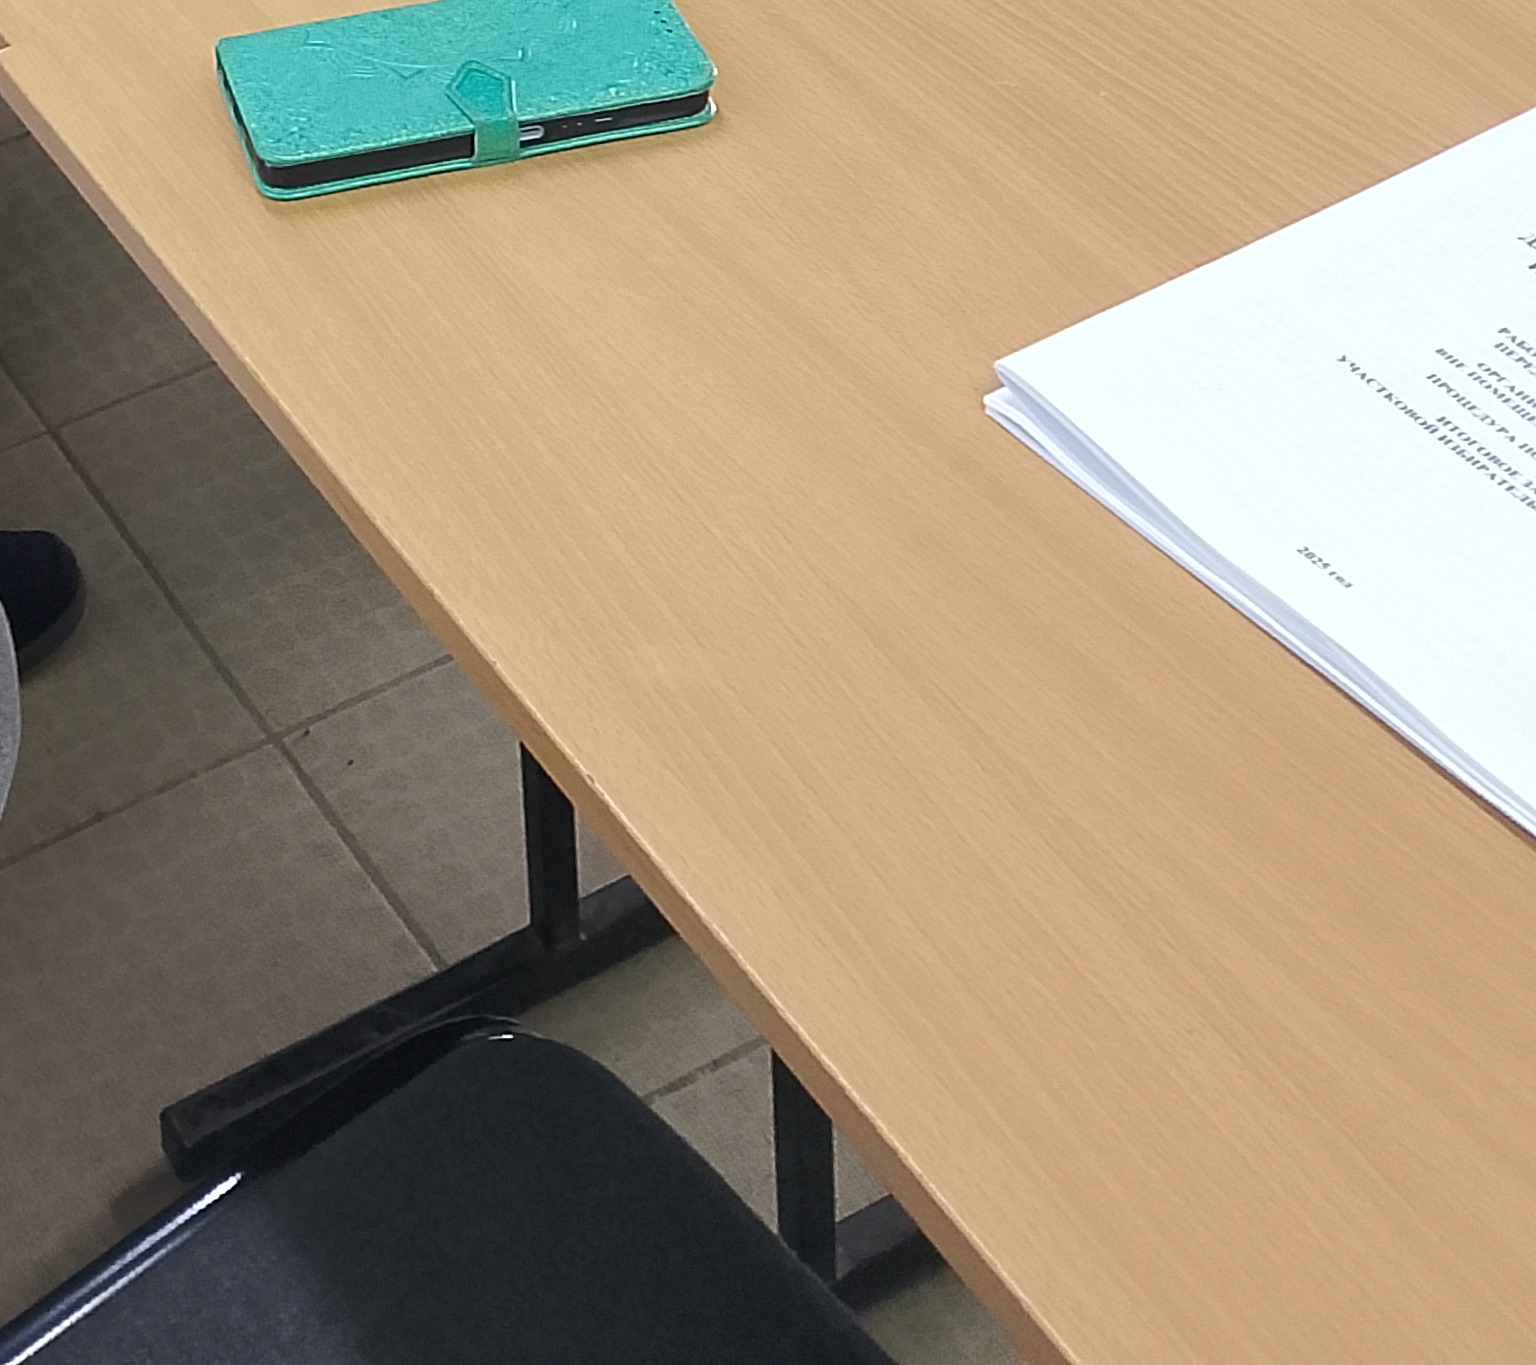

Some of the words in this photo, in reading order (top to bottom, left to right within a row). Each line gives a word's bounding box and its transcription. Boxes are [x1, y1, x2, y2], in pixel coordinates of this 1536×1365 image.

[1435, 348, 1468, 371] ВНЕ
[1336, 354, 1439, 435] УЧАСТКОВОЙ
[1426, 373, 1516, 443] ПРОЦЕДУРА
[1436, 416, 1523, 480] ИТОГОВОЕ
[1296, 545, 1331, 569] 2025
[1328, 571, 1353, 589] год
